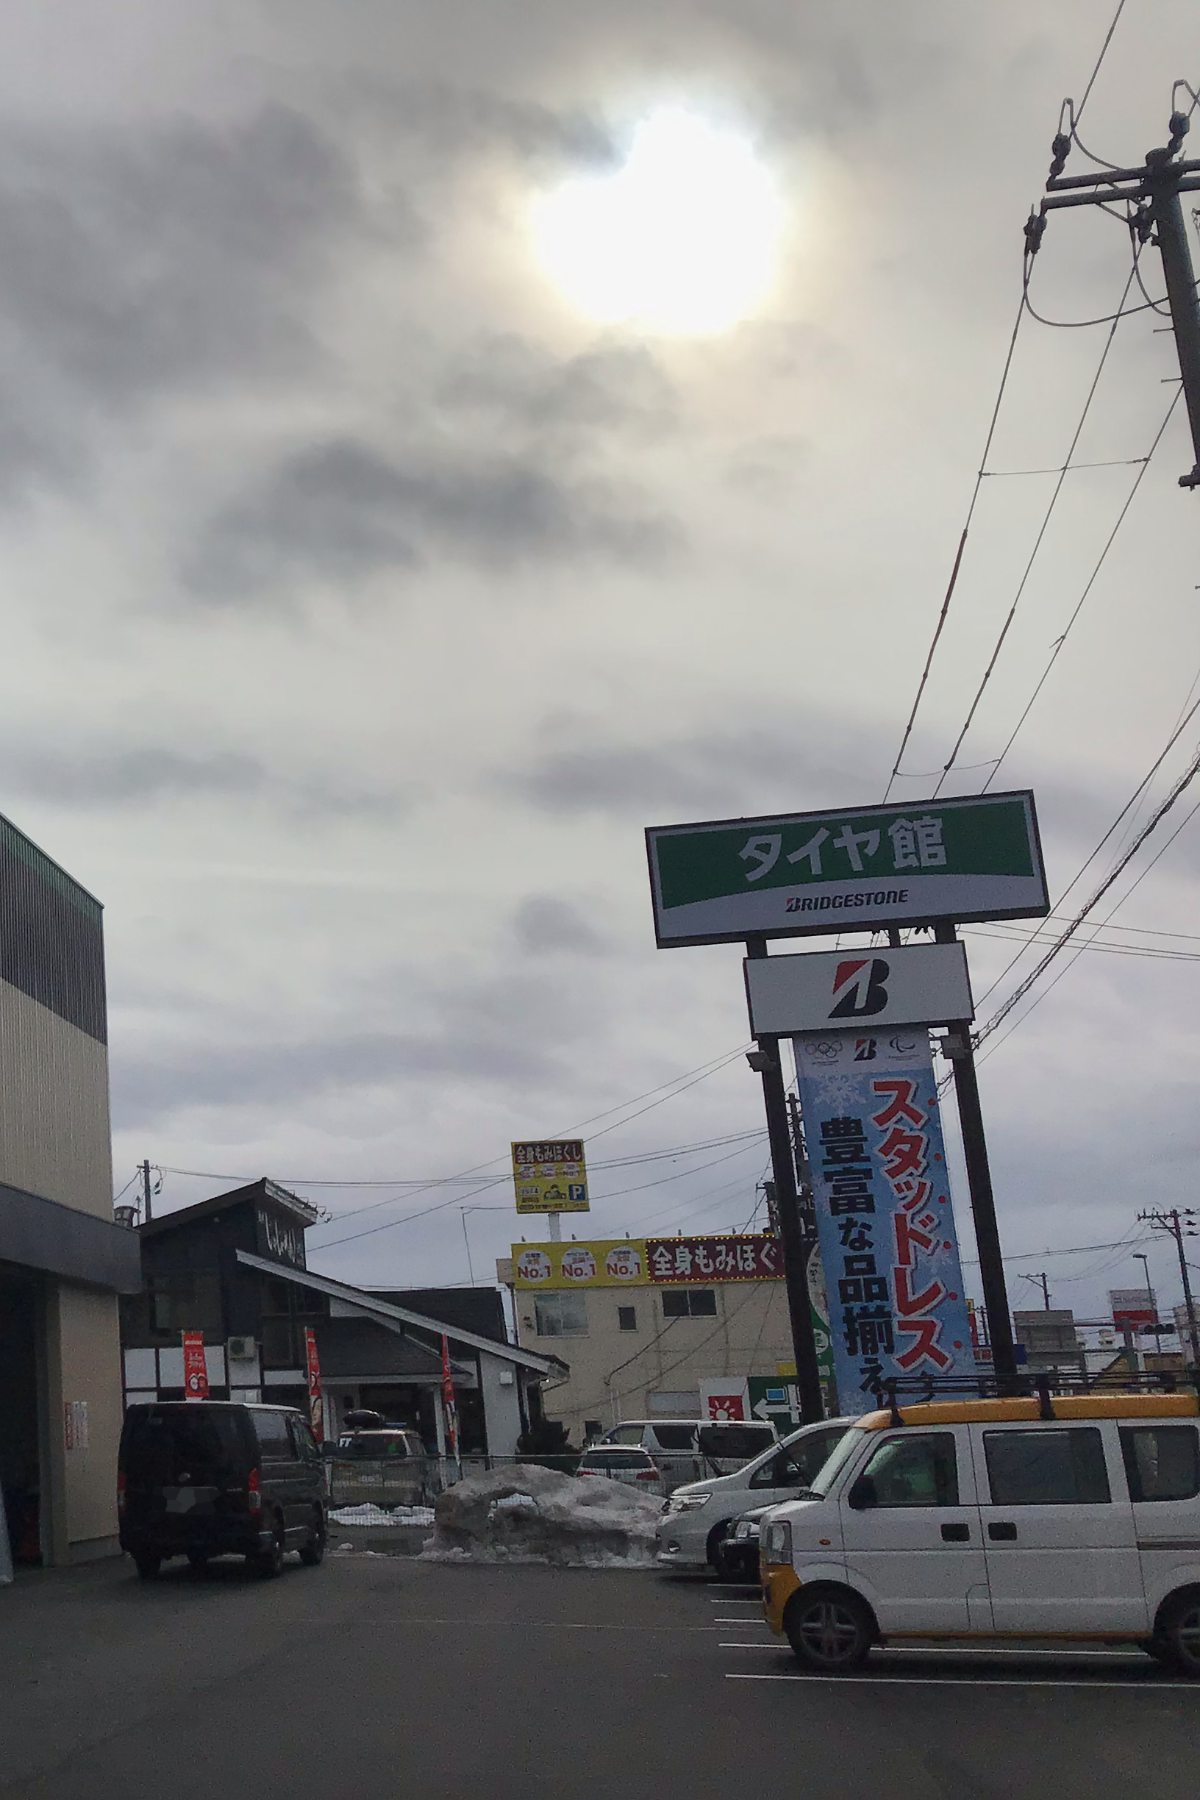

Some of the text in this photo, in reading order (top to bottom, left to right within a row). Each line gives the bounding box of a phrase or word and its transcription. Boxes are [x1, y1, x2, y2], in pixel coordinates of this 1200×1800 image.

[738, 815, 948, 882] タイヤ館
[785, 888, 909, 913] BRIDGESTONE
[870, 1078, 956, 1372] スタッドレス
[517, 1265, 551, 1279] No.1
[562, 1264, 596, 1277] No.1
[606, 1262, 641, 1275] No.1
